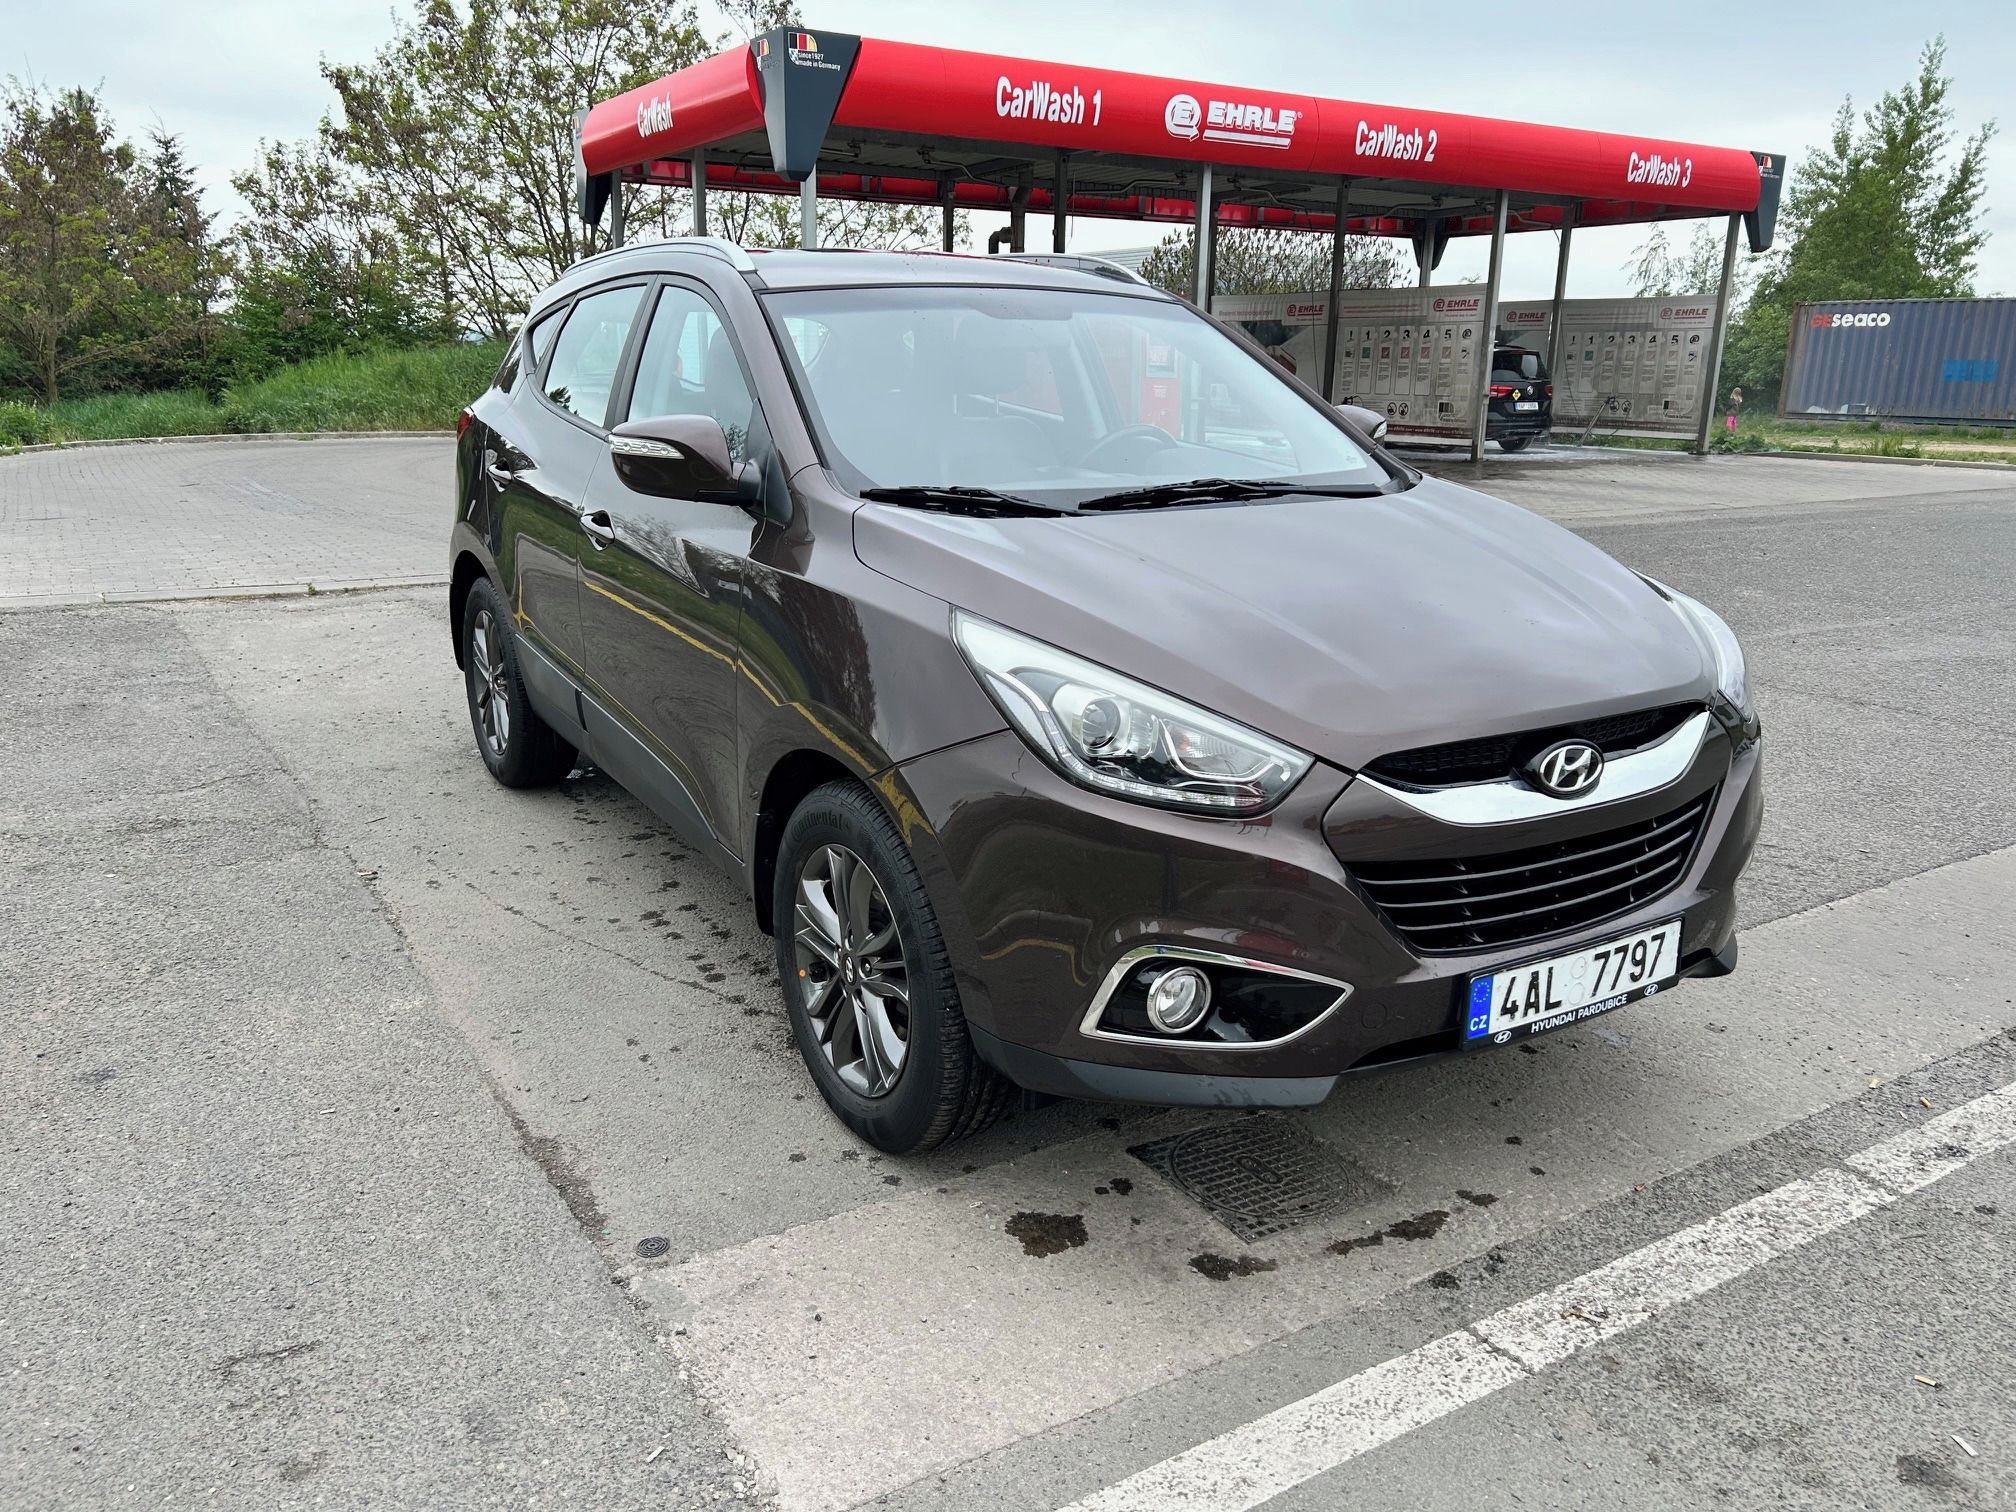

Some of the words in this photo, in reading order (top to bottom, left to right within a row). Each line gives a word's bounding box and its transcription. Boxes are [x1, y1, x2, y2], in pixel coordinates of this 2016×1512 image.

[637, 92, 674, 139] CarWash
[996, 75, 1085, 125] CarWash
[1092, 88, 1102, 127] 1
[1207, 100, 1297, 135] EHRLE
[1355, 120, 1424, 161] CarWash
[1424, 128, 1438, 162] 2
[1627, 151, 1681, 187] CarWash
[1681, 158, 1693, 188] 3
[1446, 298, 1480, 308] EHRLE
[1674, 308, 1709, 316] EHRLE
[1383, 329, 1391, 339] 2
[1402, 329, 1411, 340] 3
[1423, 329, 1431, 339] 4
[1444, 329, 1452, 340] 5
[1628, 336, 1636, 345] 3
[1671, 335, 1679, 345] 5
[1500, 967, 1562, 1020] 4AL
[1591, 931, 1667, 998] 7797
[1469, 1014, 1487, 1031] CZ
[1530, 1011, 1576, 1034] HYUNDAI
[1577, 993, 1628, 1020] PARDUBICE
